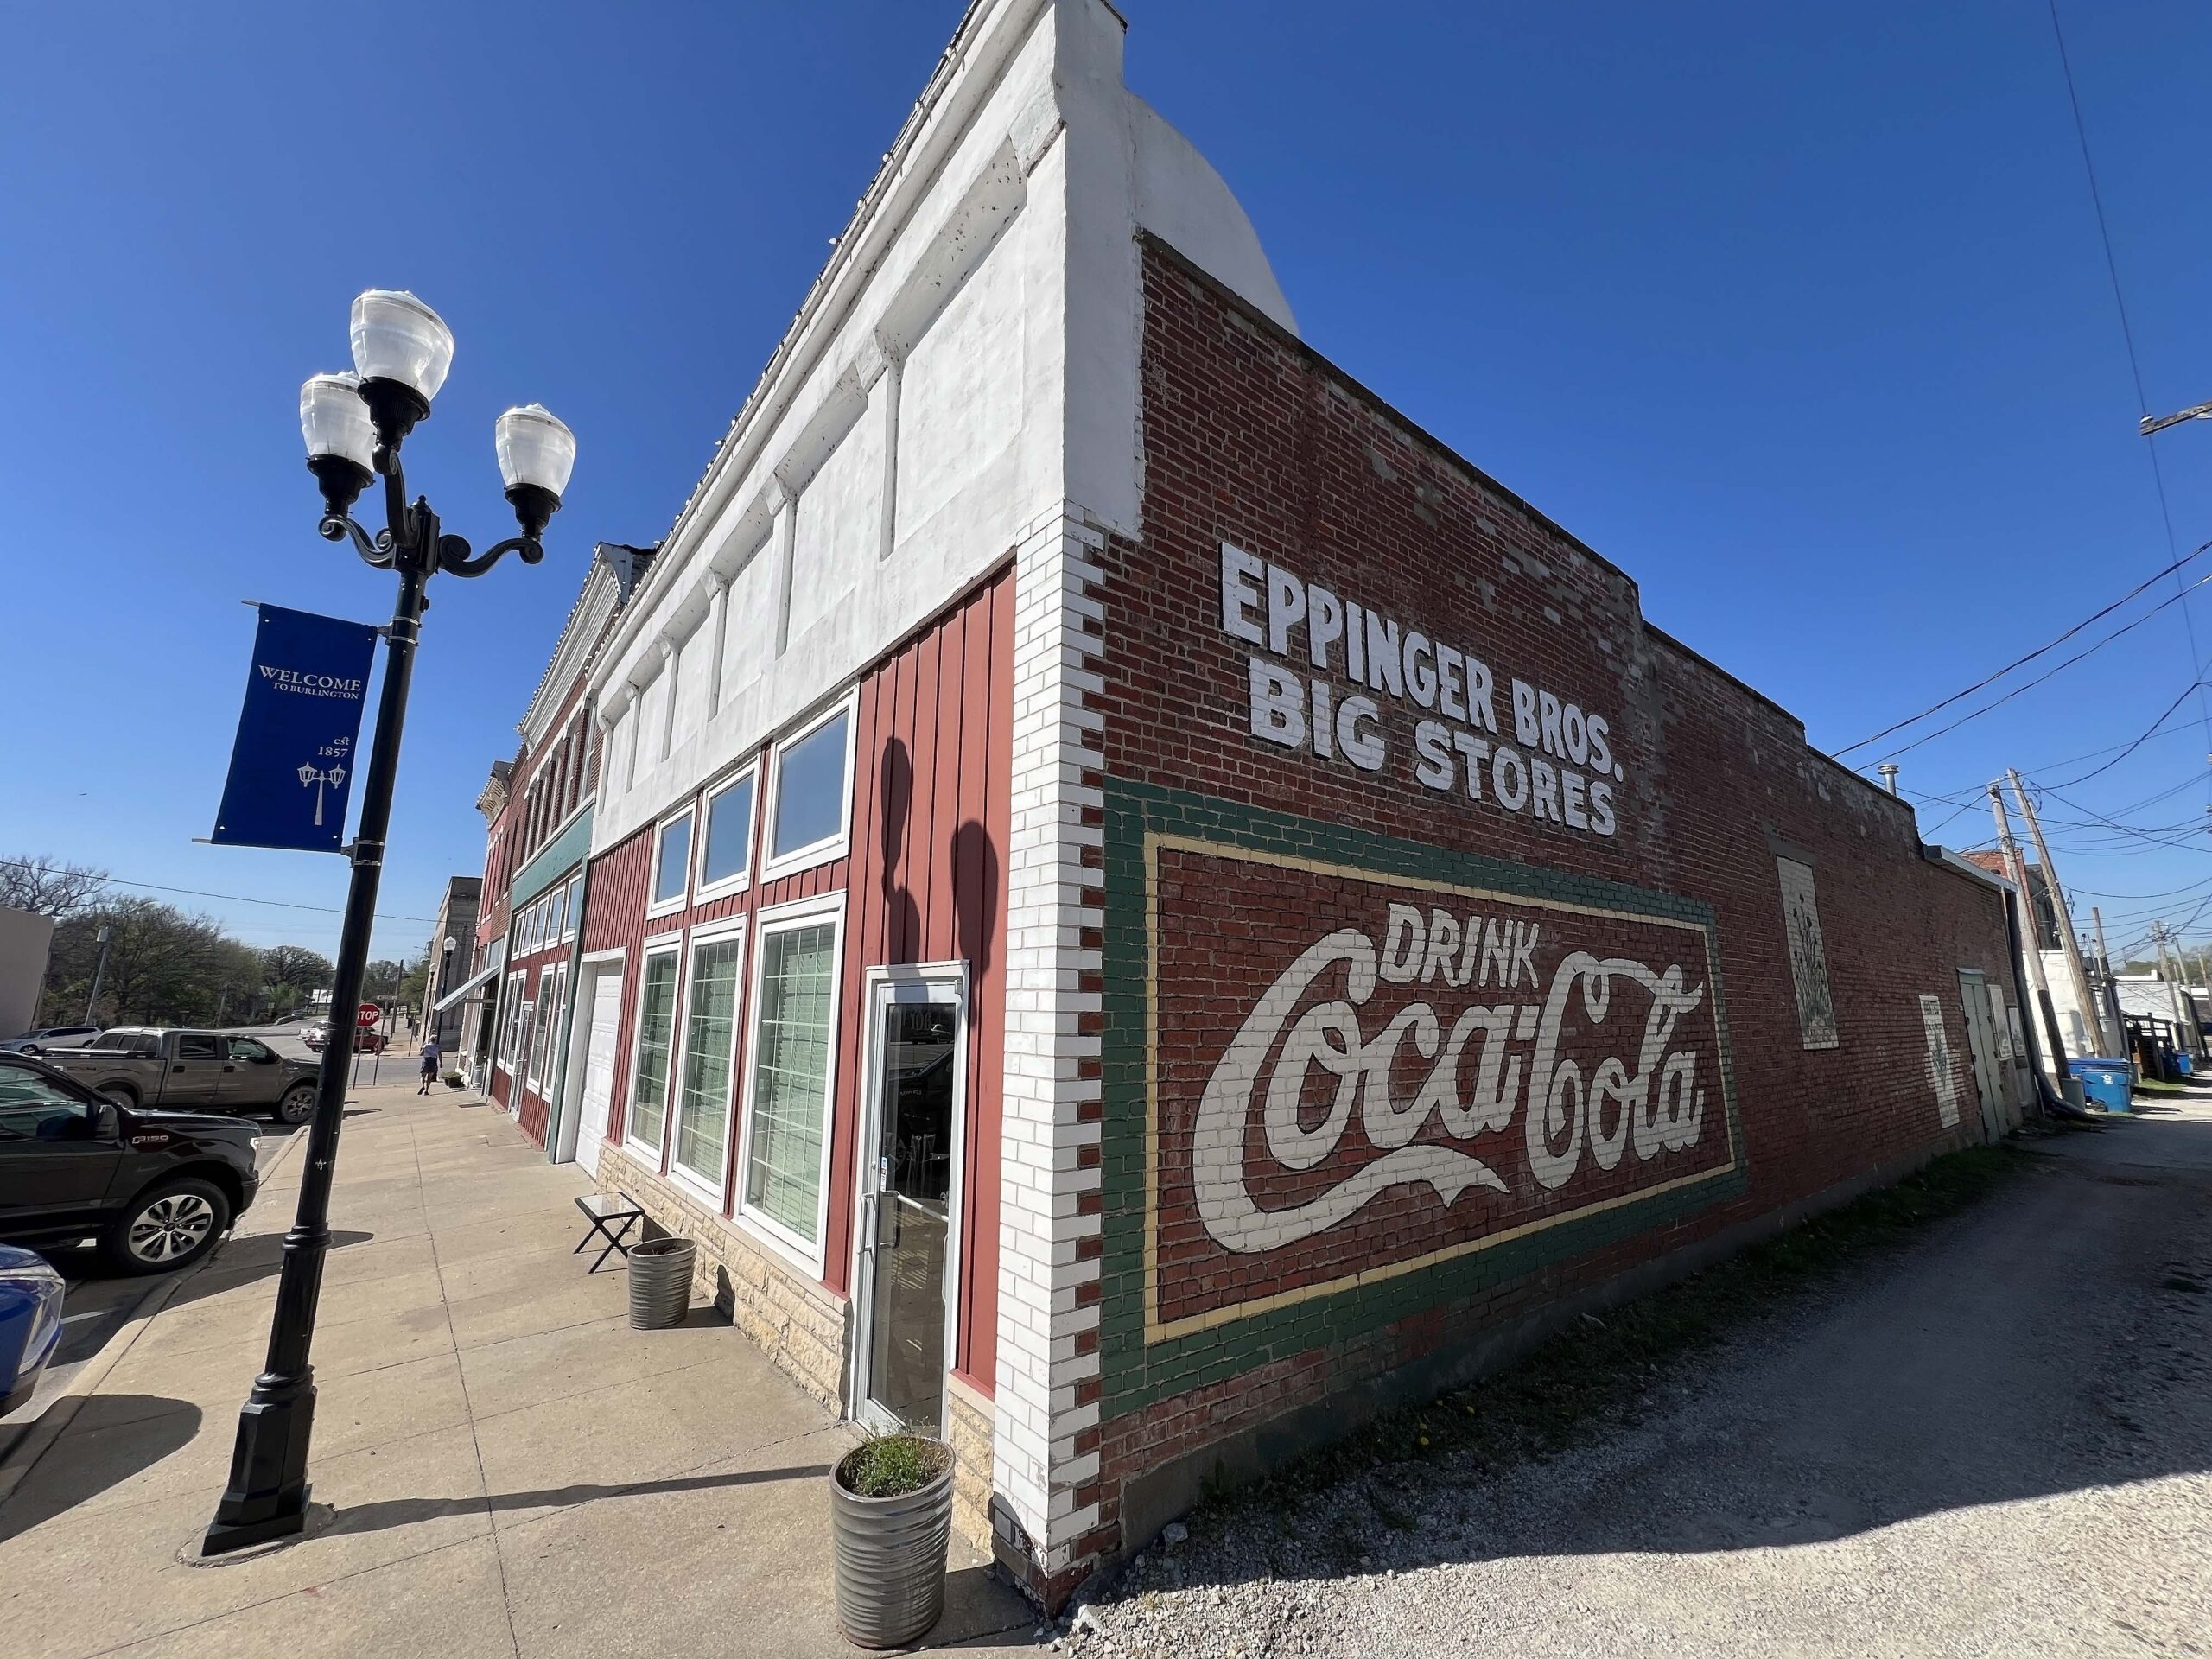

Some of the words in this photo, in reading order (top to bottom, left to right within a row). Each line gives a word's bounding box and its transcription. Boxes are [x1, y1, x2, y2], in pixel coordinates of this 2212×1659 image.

[258, 664, 361, 691] WELCOME
[1220, 541, 1498, 735] EPPINGER
[1511, 678, 1624, 783] BROS.
[272, 682, 289, 690] TO
[290, 685, 359, 700] BURLINGTON
[318, 747, 348, 757] 1857
[334, 736, 350, 746] est
[1249, 657, 1386, 772] BIG
[1414, 720, 1616, 836] STORES
[1378, 902, 1540, 988] DRINK
[1192, 928, 1704, 1253] Coca-Cola
